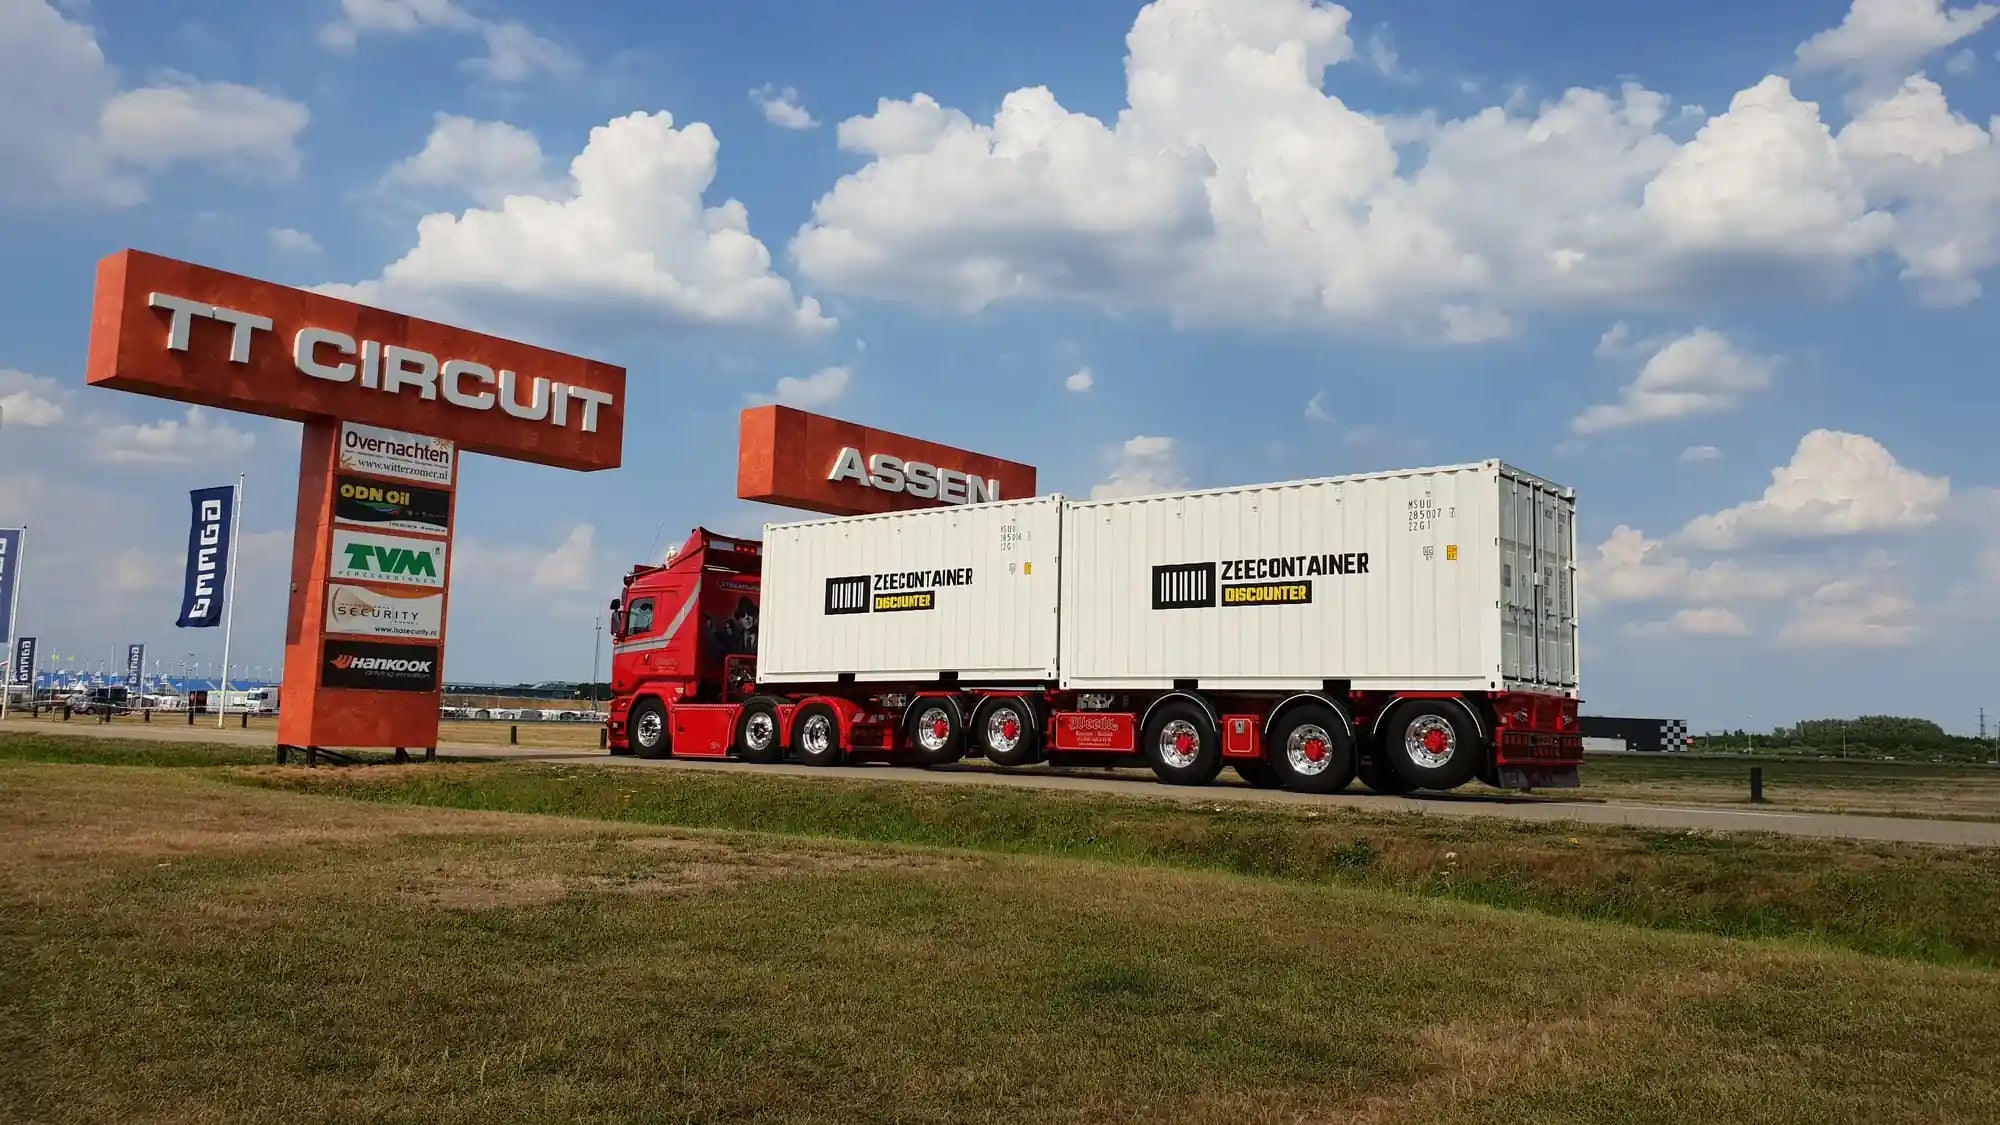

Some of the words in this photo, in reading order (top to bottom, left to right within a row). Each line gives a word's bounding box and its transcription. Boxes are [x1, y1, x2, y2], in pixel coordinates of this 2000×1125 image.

[149, 292, 274, 364] TT
[293, 327, 613, 432] CIRCUIT
[345, 430, 449, 463] Overnachten
[358, 459, 448, 480] www.witterzomer.nl
[827, 447, 1000, 504] ASSEN
[340, 483, 383, 502] ODN
[386, 490, 410, 505] Oil
[1408, 499, 1431, 509] MSUU
[1408, 508, 1441, 520] 285007
[1408, 520, 1431, 531] 22G1
[344, 543, 436, 577] TVM
[1221, 552, 1369, 580] ZEECONTAINER
[874, 568, 973, 590] ZEECONTAINER
[875, 594, 930, 609] DISCOUNTER
[1225, 585, 1306, 602] DISCOUNTER
[338, 606, 419, 620] SECURITY
